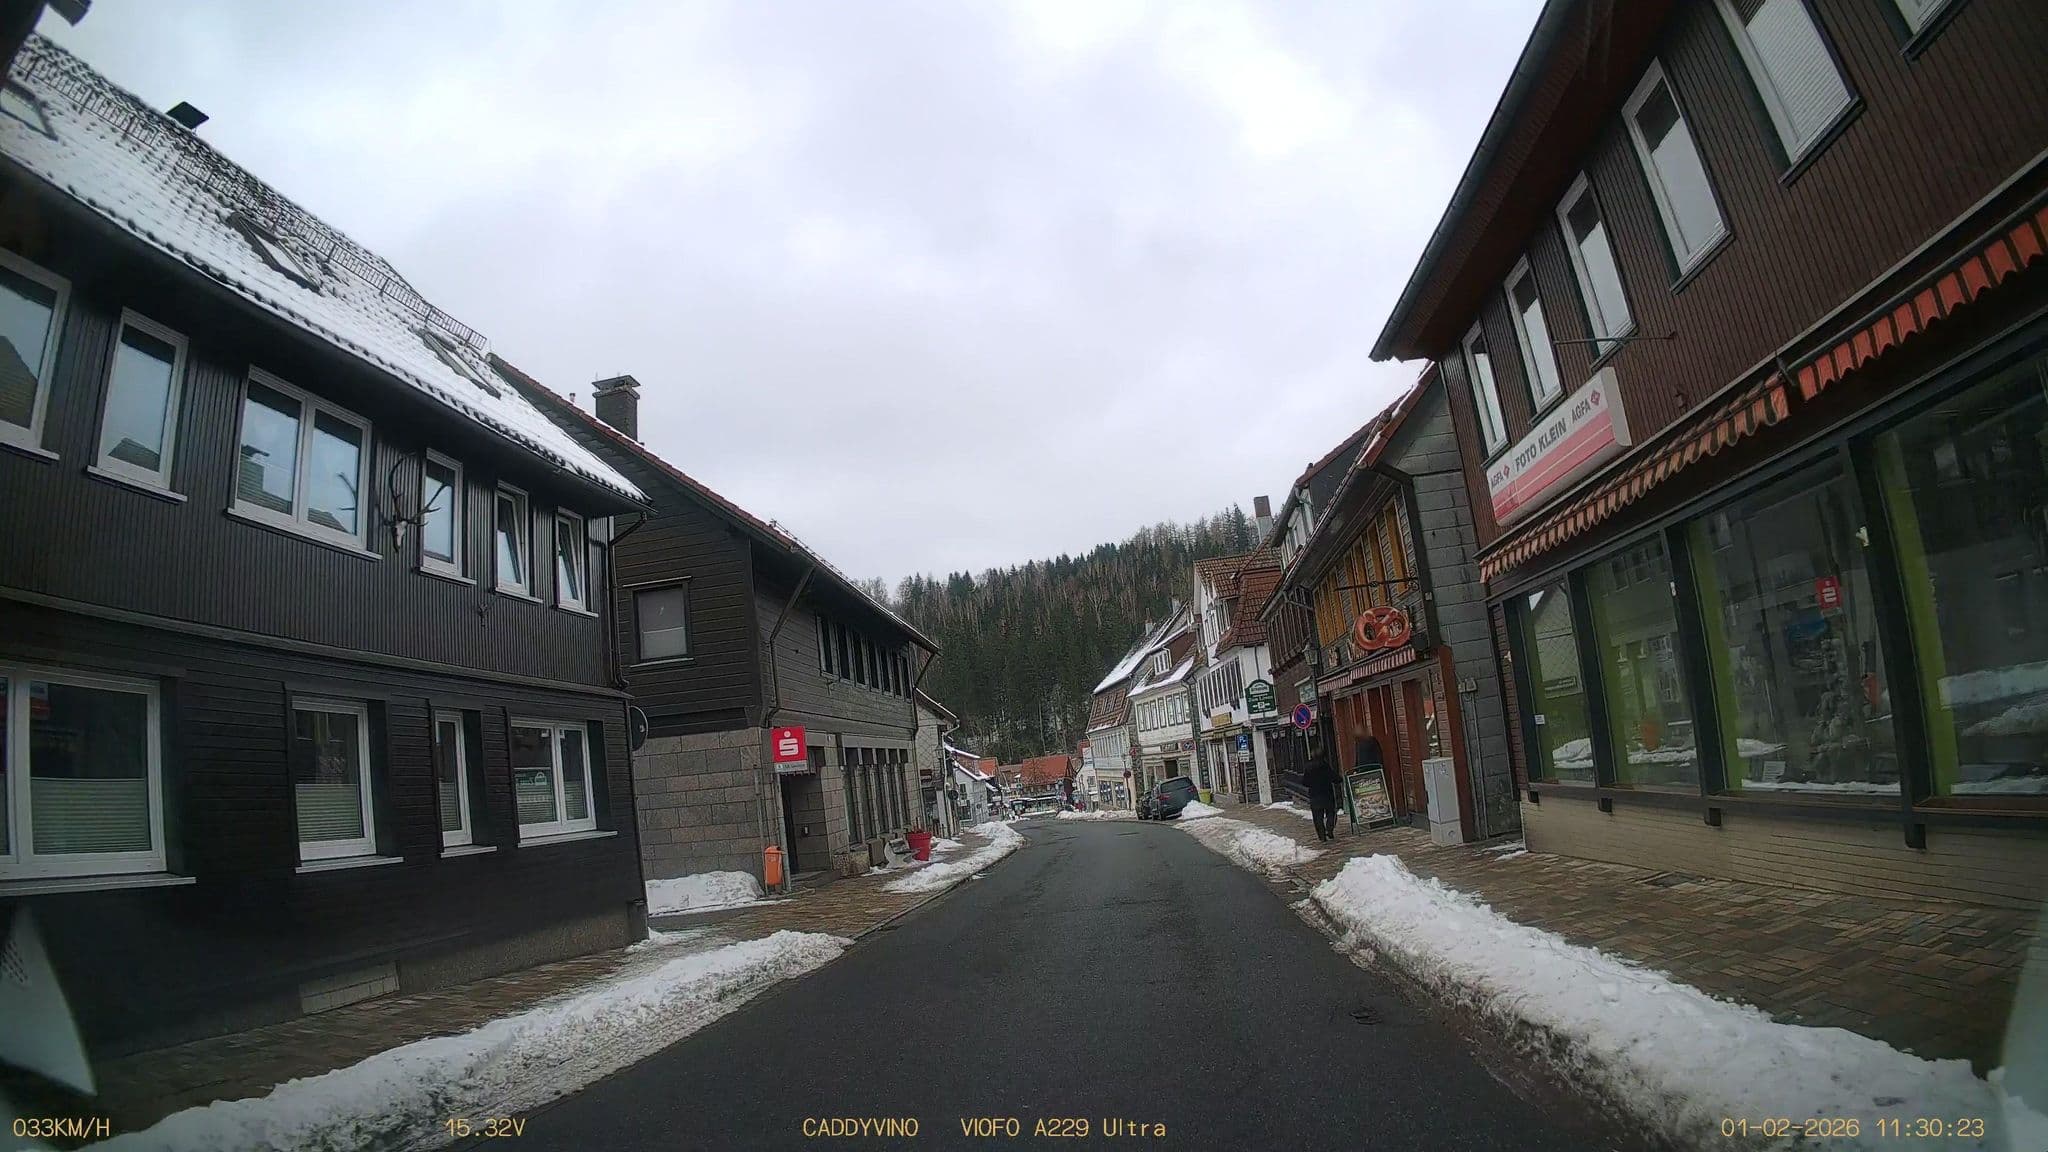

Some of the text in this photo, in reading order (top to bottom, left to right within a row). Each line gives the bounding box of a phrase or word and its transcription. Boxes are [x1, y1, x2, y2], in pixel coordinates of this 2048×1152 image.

[1491, 398, 1590, 489] AGFA FOTO KLEIN AGFA
